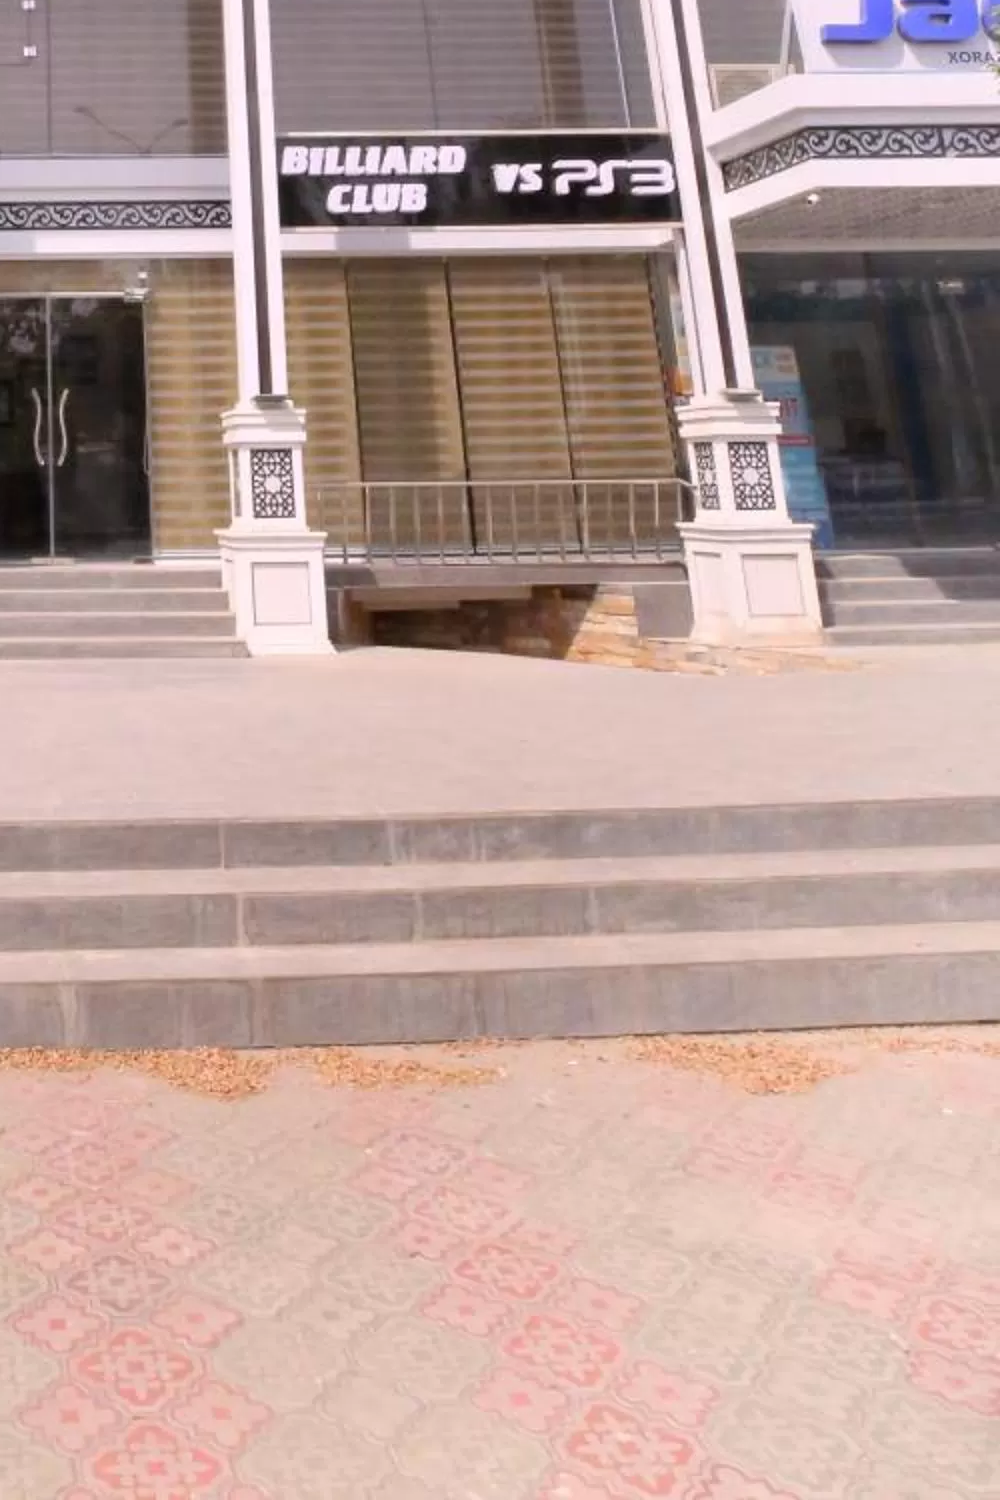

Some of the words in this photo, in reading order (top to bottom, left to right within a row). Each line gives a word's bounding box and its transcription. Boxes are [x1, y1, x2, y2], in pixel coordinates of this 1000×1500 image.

[948, 51, 1000, 64] XORA
[281, 145, 467, 175] BILLIARD
[552, 159, 676, 195] PS3
[326, 183, 427, 213] CLUB
